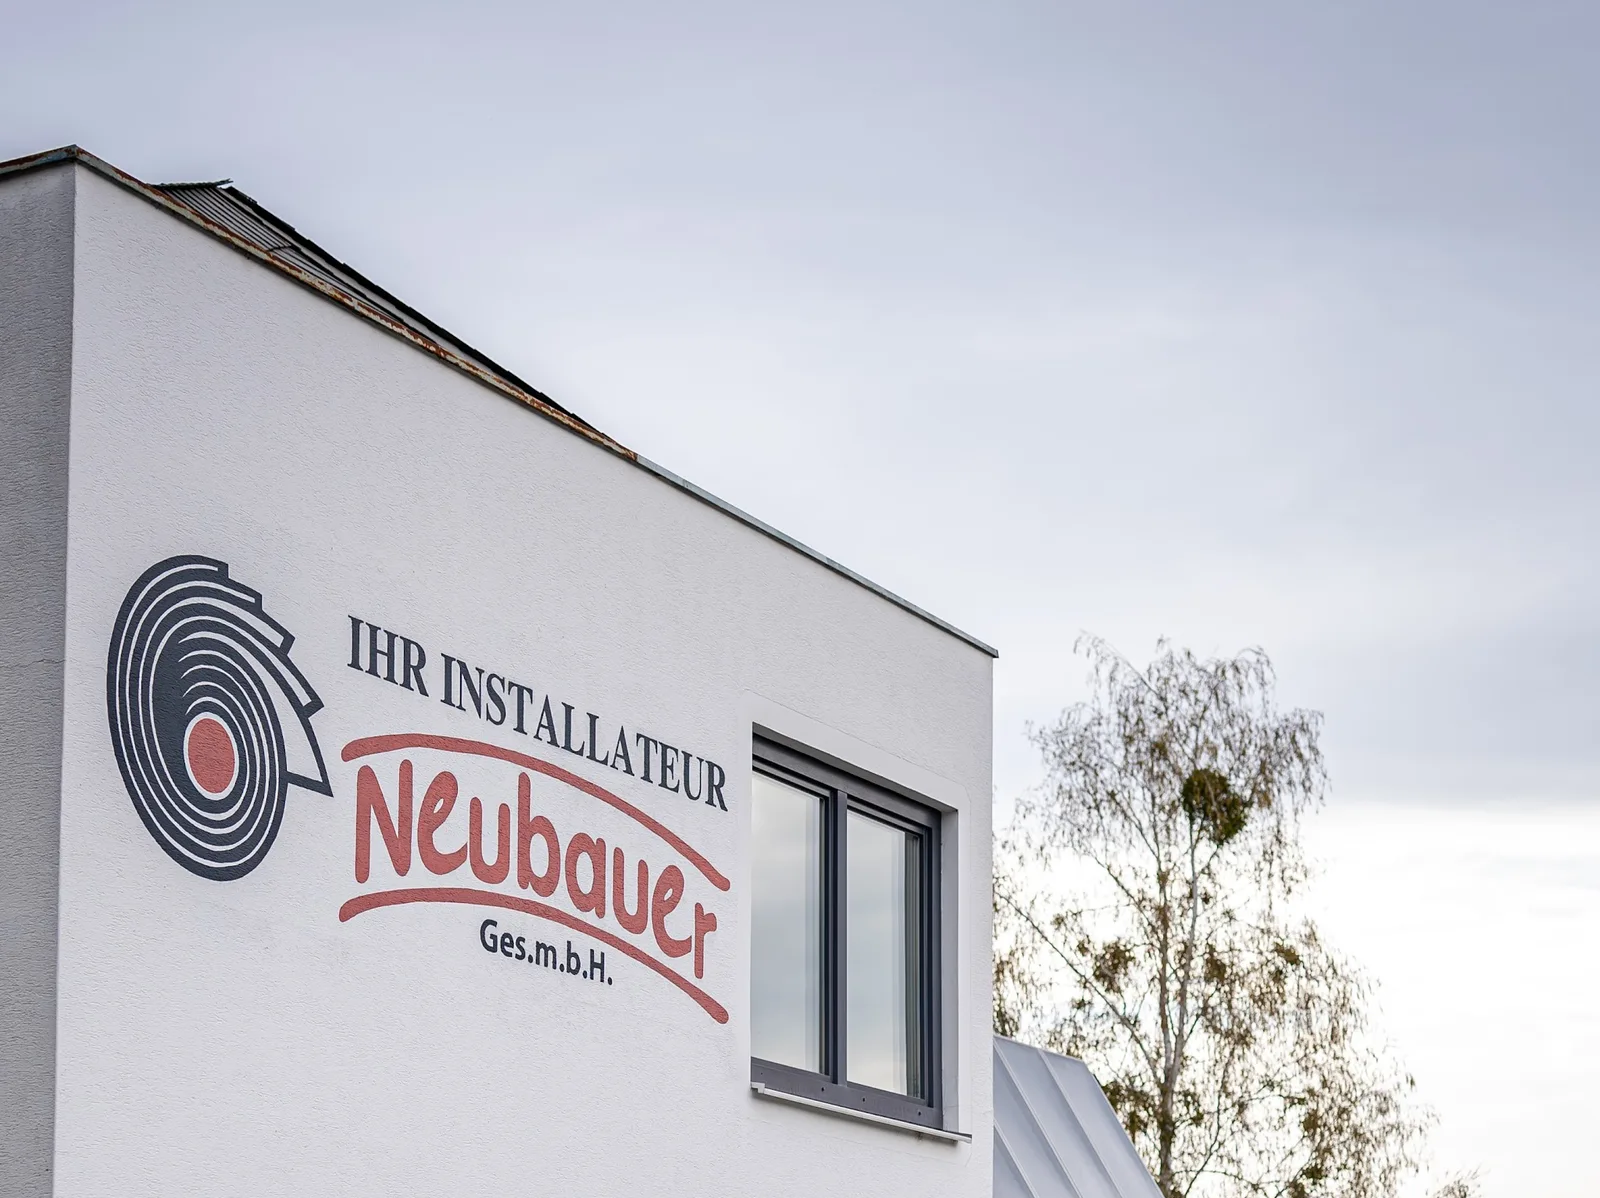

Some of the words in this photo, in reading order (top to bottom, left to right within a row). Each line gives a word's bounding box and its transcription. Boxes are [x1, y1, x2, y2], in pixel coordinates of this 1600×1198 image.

[347, 615, 429, 697] IHR
[440, 652, 728, 812] INSTALLATEUR
[354, 758, 717, 980] Neubauer
[479, 918, 613, 986] Ges.m.b.H.
